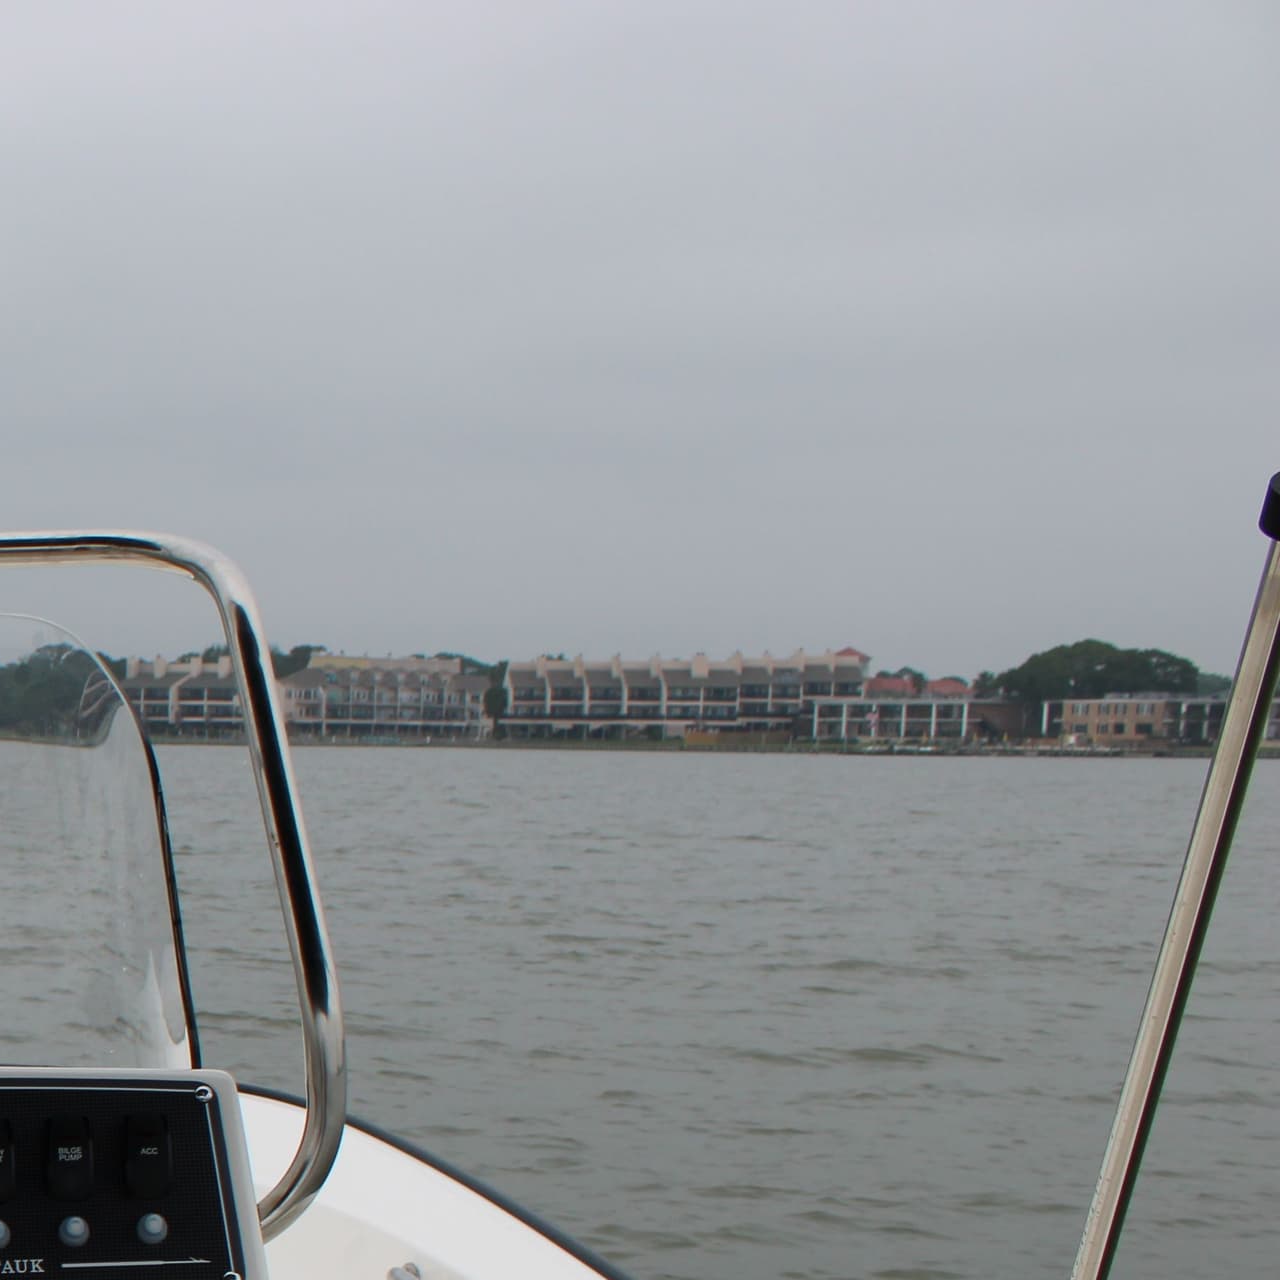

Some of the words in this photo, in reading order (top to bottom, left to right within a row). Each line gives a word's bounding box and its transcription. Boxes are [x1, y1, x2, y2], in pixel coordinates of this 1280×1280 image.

[58, 1146, 82, 1155] BILGE
[140, 1147, 158, 1156] ACC
[58, 1153, 82, 1162] PUMP
